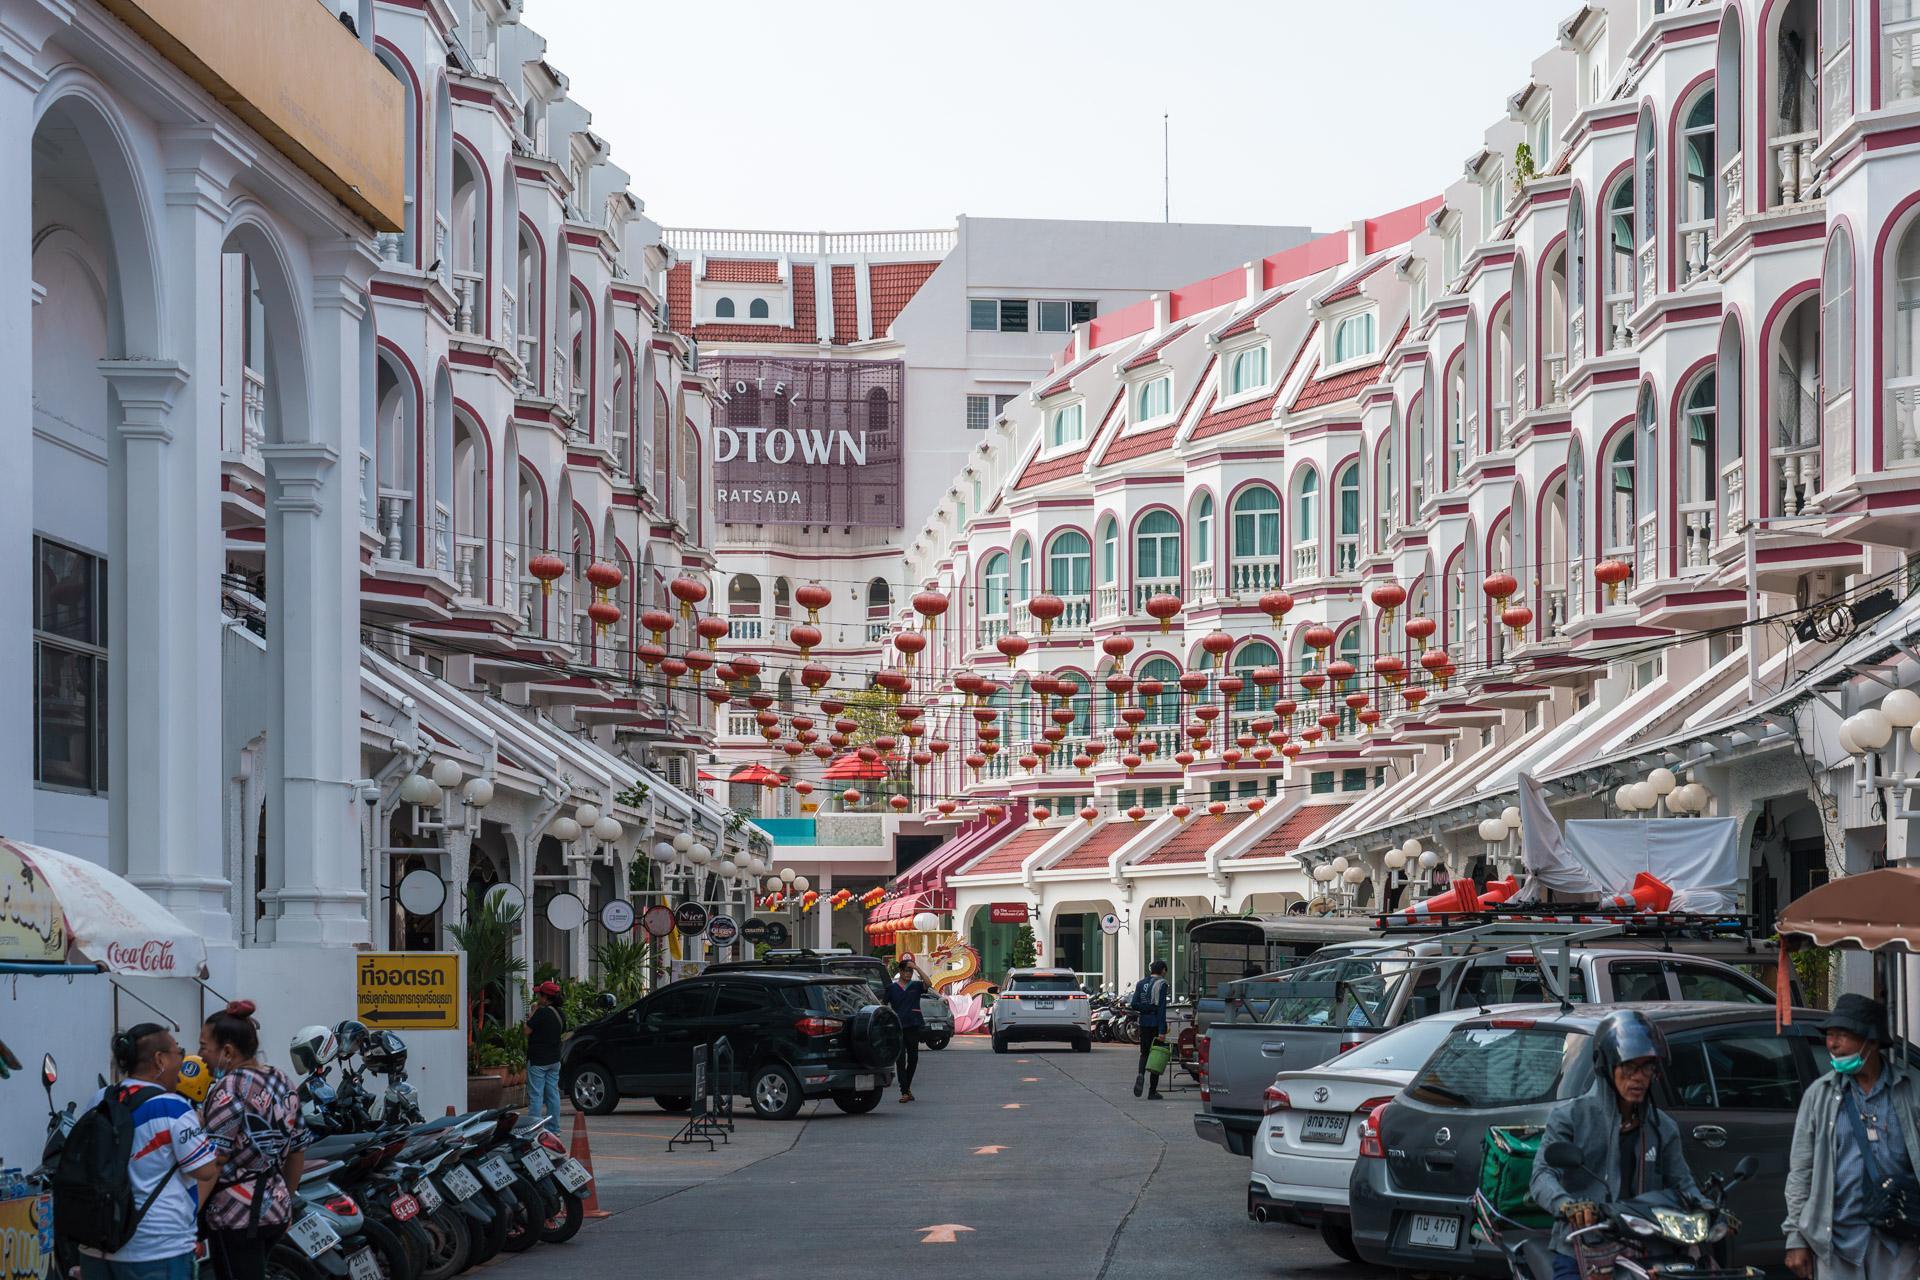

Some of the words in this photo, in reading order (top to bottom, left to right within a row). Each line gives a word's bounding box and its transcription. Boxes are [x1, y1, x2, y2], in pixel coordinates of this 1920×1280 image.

[716, 377, 800, 407] HOTEL
[717, 489, 801, 504] RATSADA
[361, 959, 445, 986] ที่จอดรถ
[357, 990, 452, 1008] ำหรับลูกค้าธนาคารกรุงศรีอยุธยา
[1324, 1116, 1345, 1129] 7568
